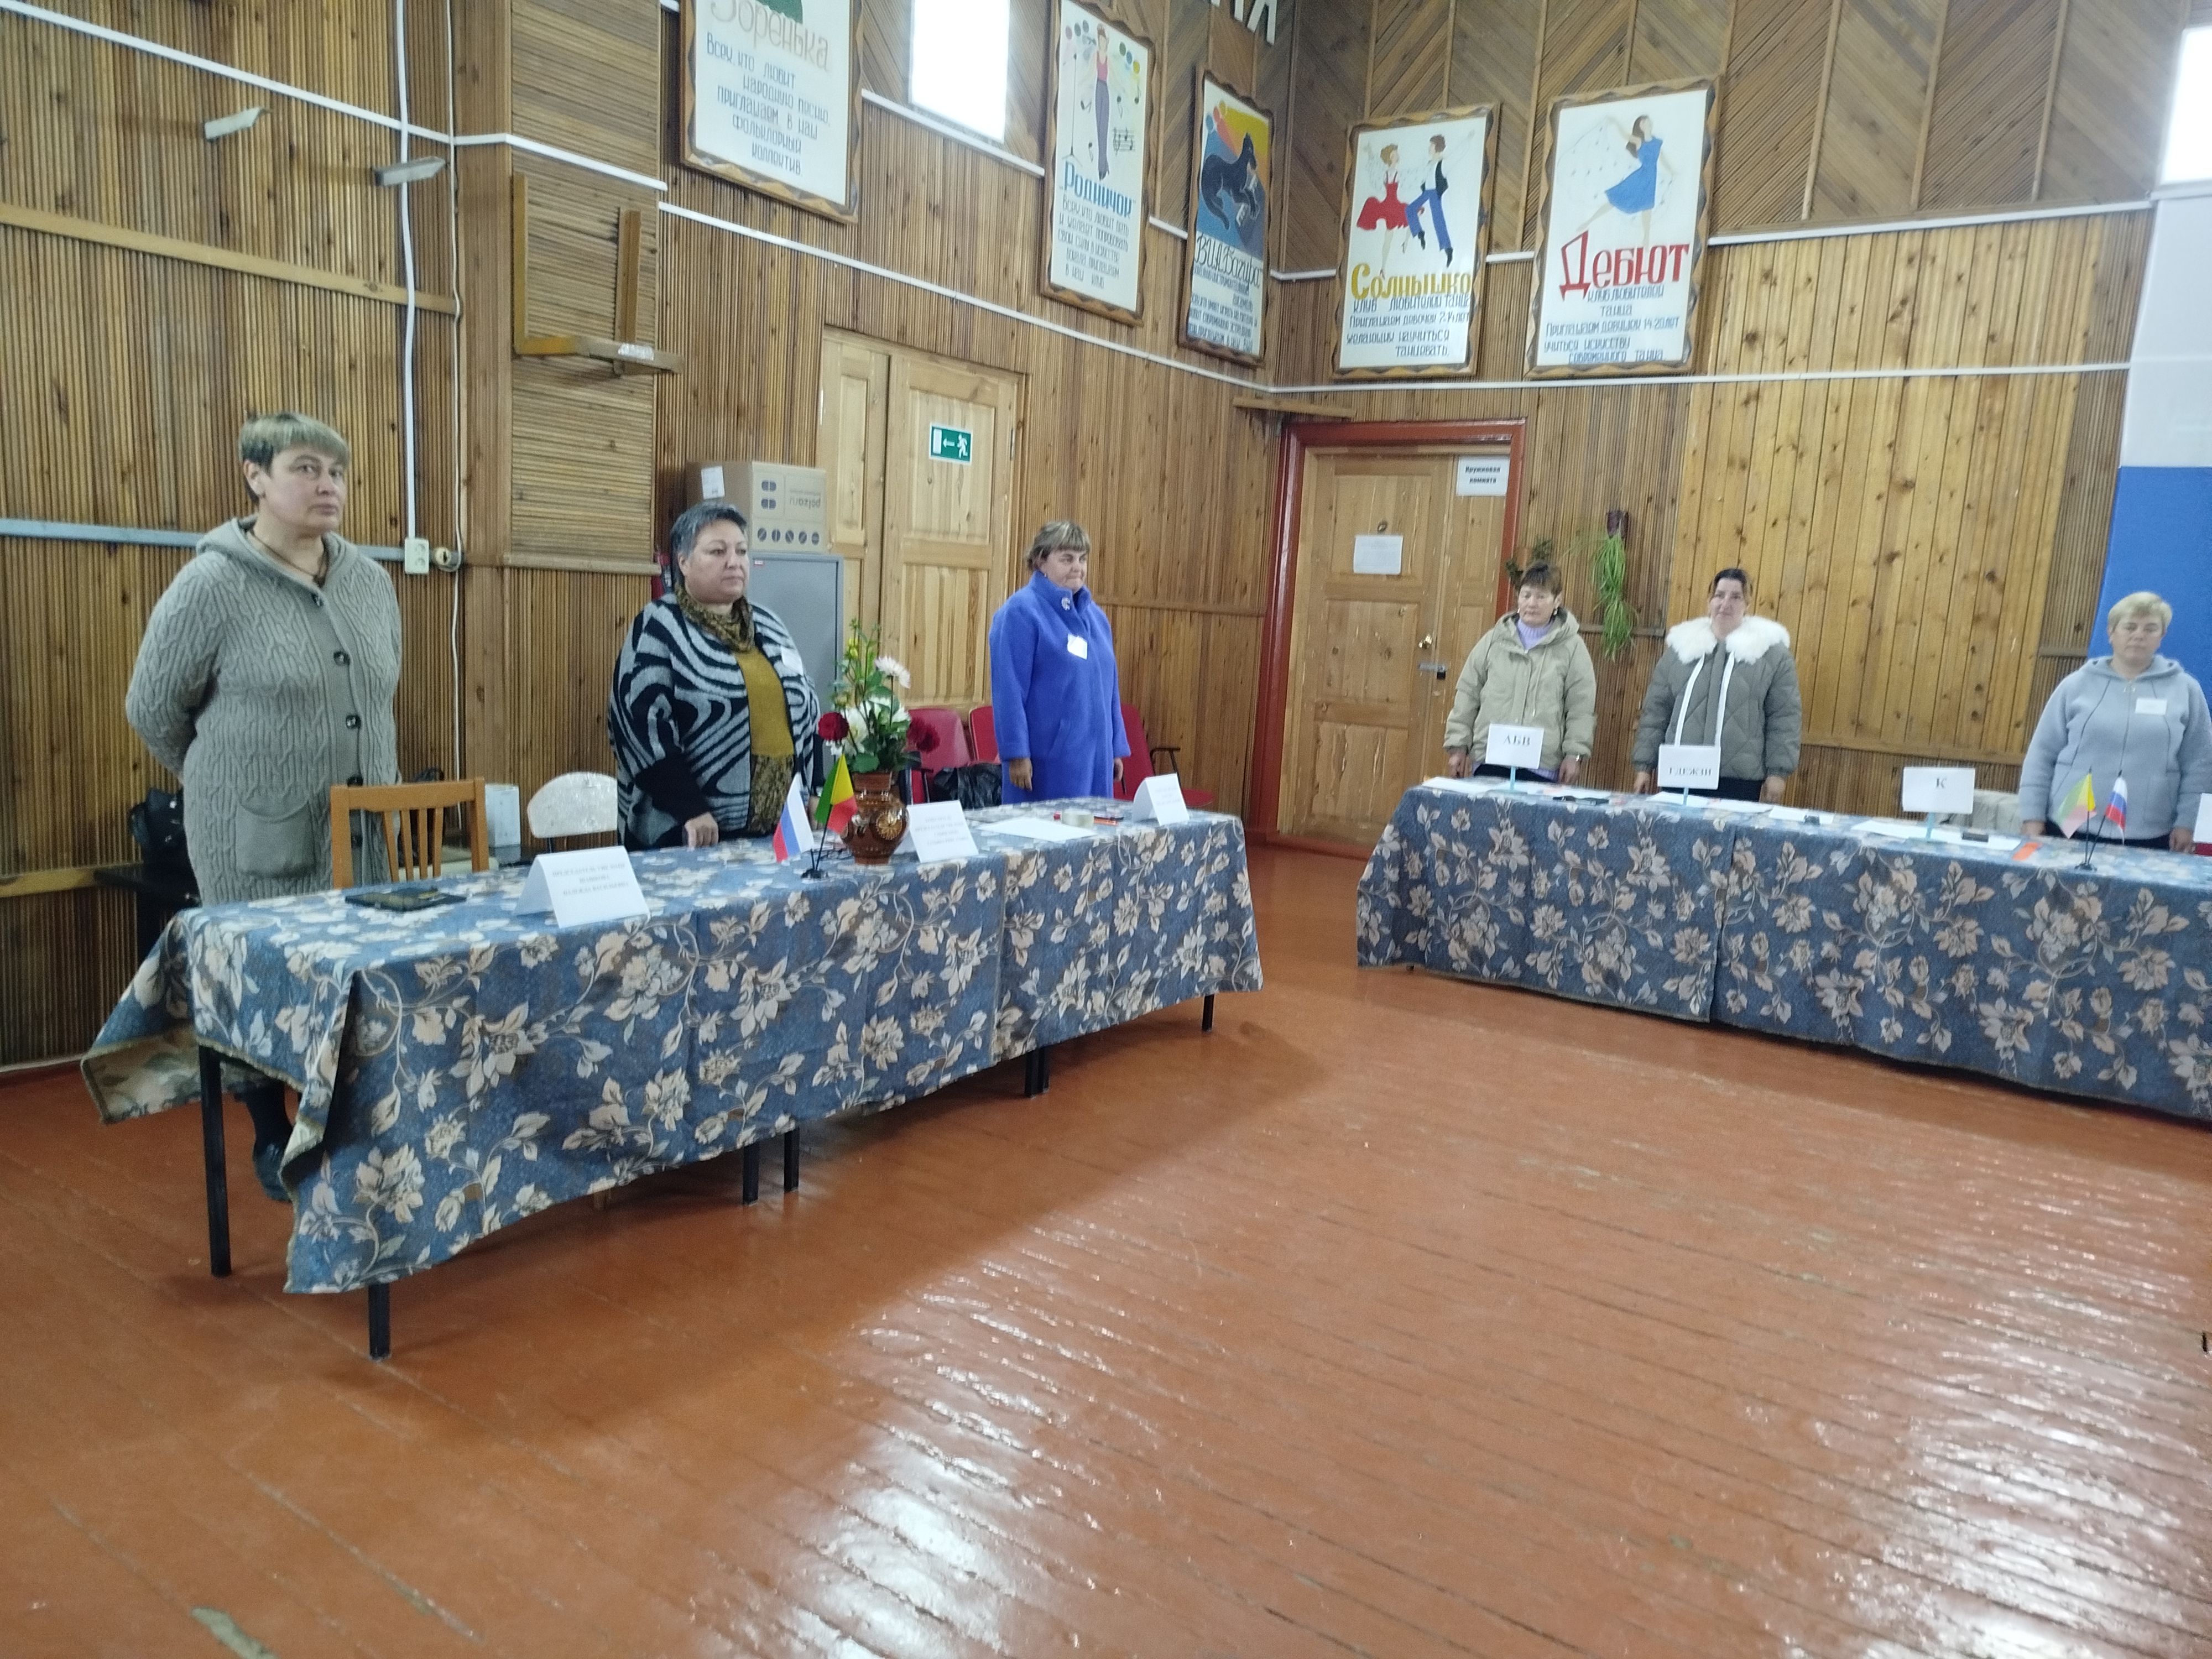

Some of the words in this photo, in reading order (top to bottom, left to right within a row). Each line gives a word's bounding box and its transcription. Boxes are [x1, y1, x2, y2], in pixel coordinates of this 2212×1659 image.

[738, 50, 755, 71] кто
[764, 62, 796, 88] любит
[743, 74, 794, 109] народную
[718, 85, 779, 125] приглашаем
[787, 113, 793, 130] в
[799, 118, 817, 140] наш
[732, 114, 801, 154] фольклорный
[1060, 212, 1064, 225] и
[1082, 205, 1092, 222] кто
[1094, 212, 1114, 230] любит
[1559, 230, 1690, 301] Дебют
[1351, 262, 1471, 300] Солнышко
[1600, 304, 1632, 317] танца
[1350, 315, 1401, 329] Приглашаем
[1403, 314, 1437, 326] девочек
[1546, 322, 1599, 338] Приглашаем
[1347, 331, 1395, 345] желающих
[1399, 329, 1449, 343] научиться
[1544, 340, 1579, 353] учиться
[1584, 336, 1631, 351] искусству
[1504, 734, 1530, 747] АБВ
[1936, 776, 1947, 789] К
